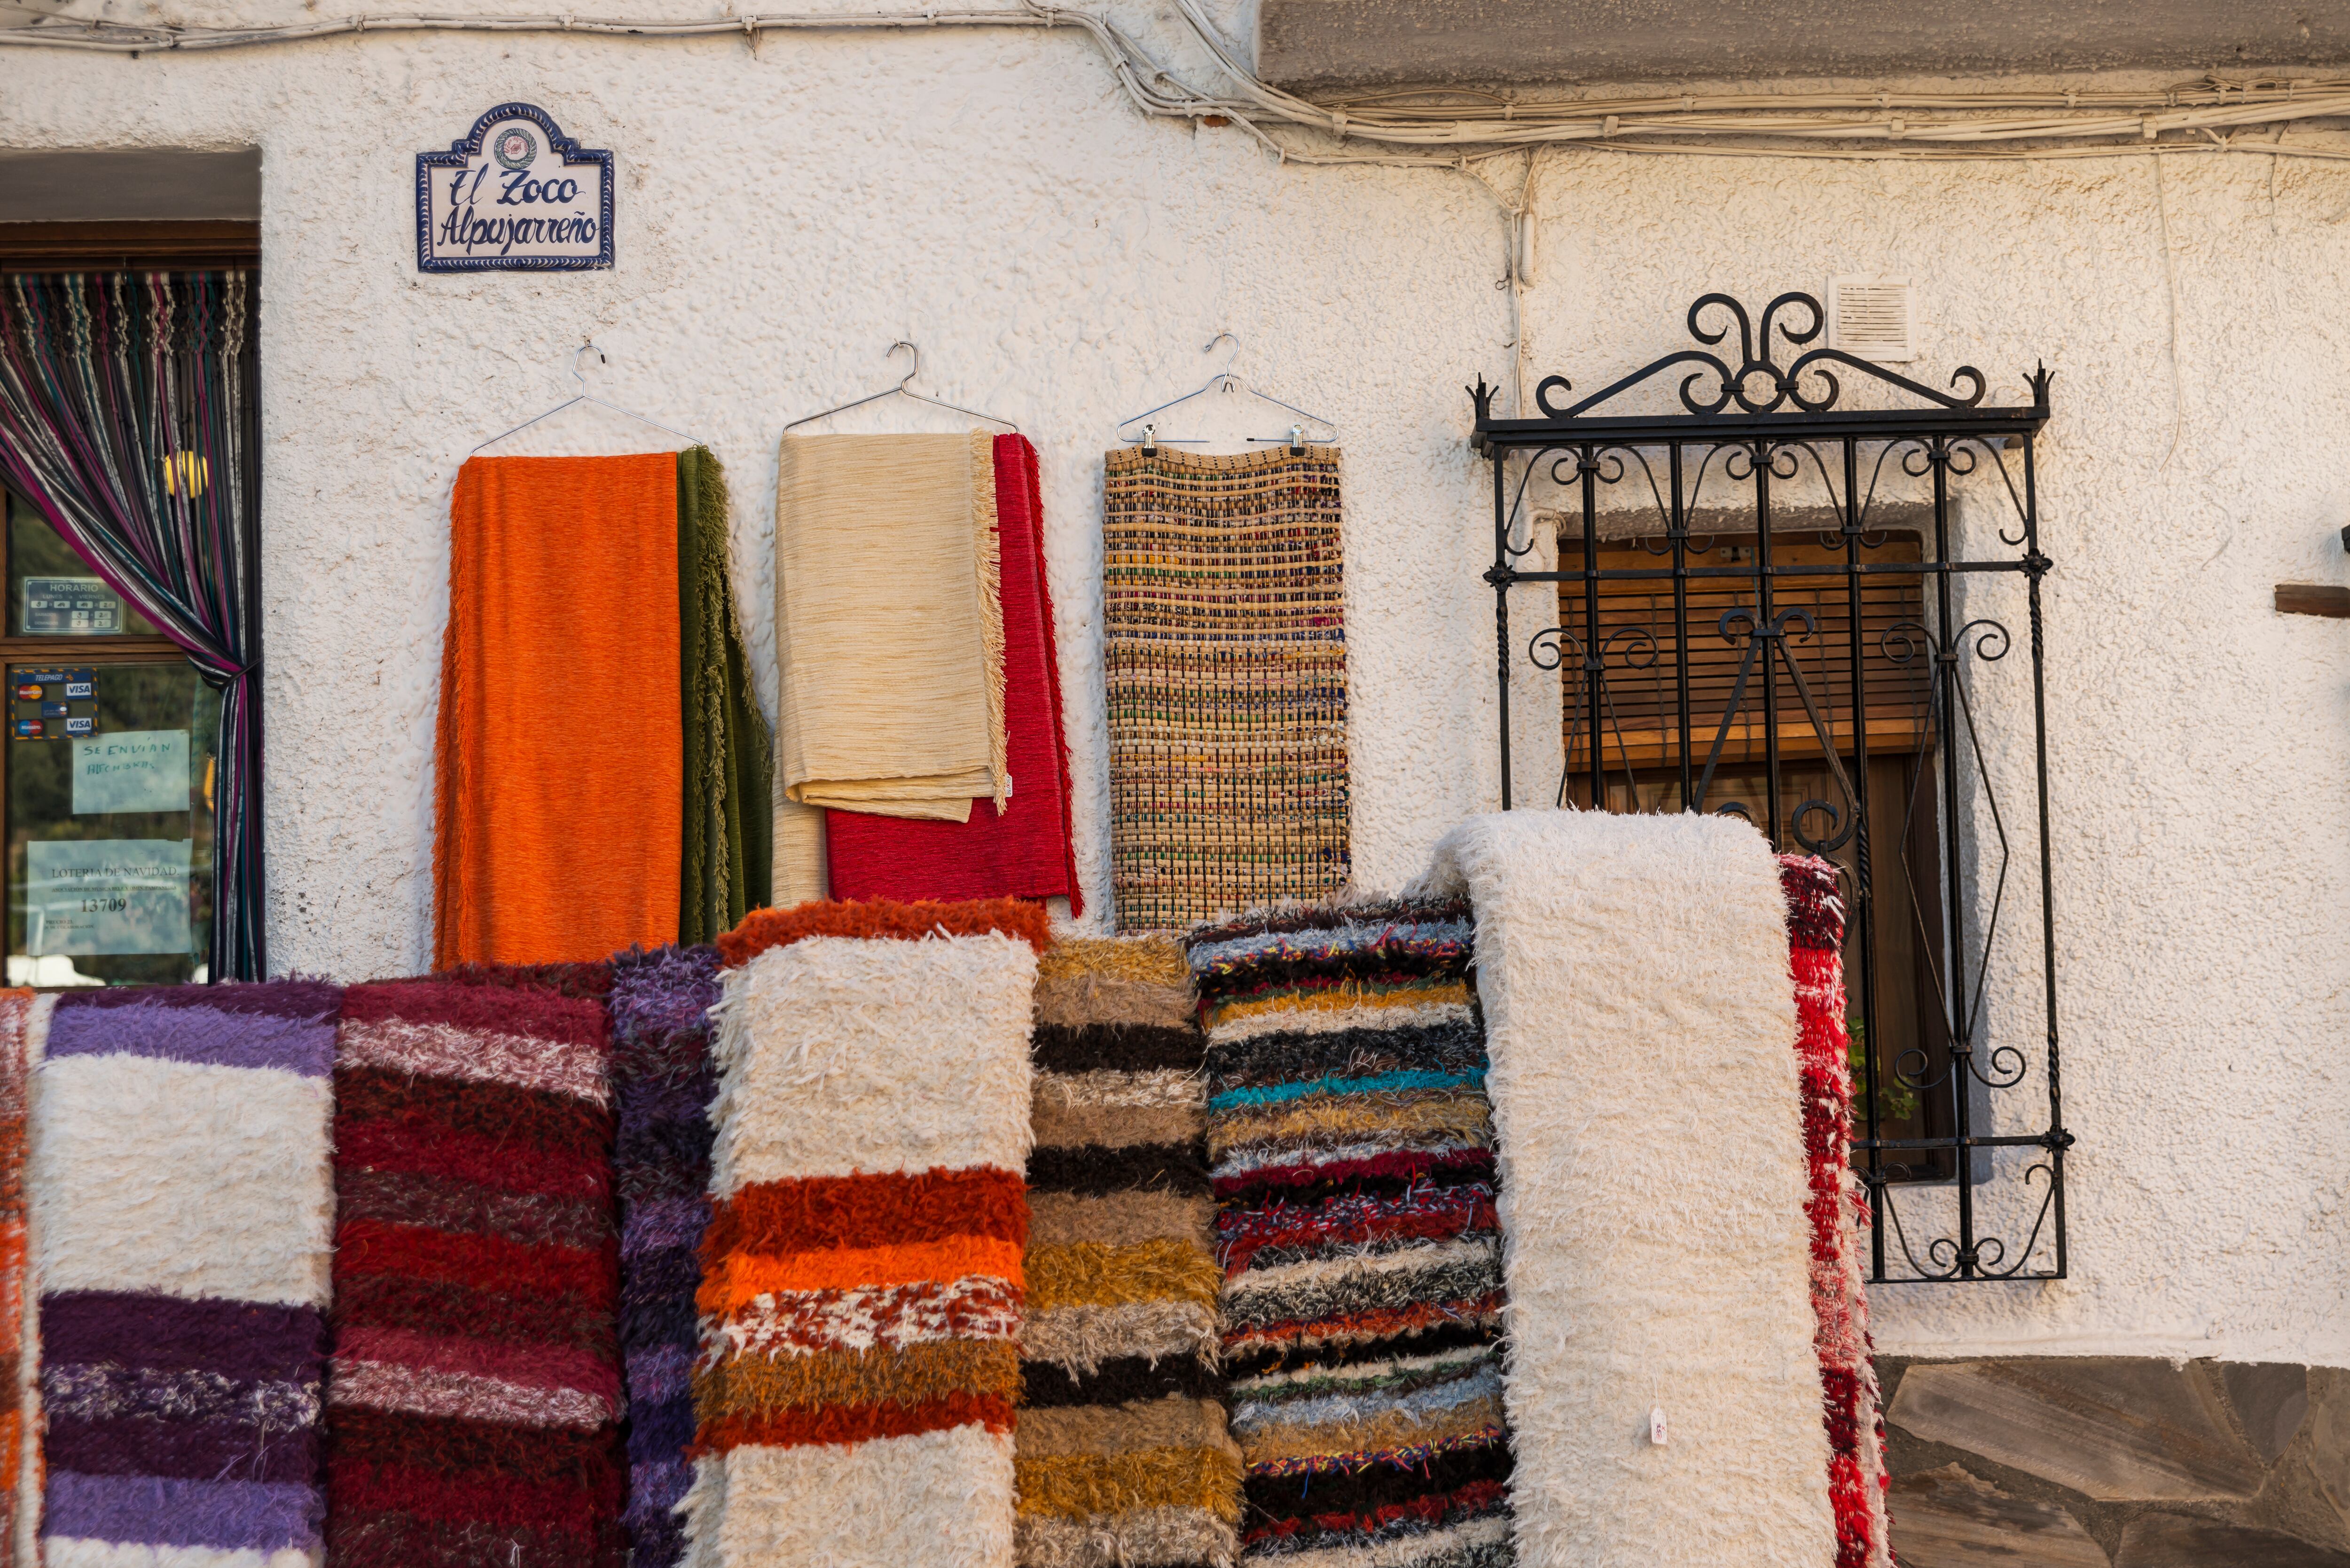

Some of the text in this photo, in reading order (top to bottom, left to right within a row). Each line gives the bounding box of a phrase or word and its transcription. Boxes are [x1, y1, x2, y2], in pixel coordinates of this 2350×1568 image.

[450, 163, 586, 206] El Zoco
[437, 205, 600, 256] Alpujarreño
[69, 685, 90, 693] VISA
[84, 746, 102, 756] SE
[52, 866, 180, 878] LOTERIA DE NAVIDAD.
[81, 898, 126, 912] 13709
